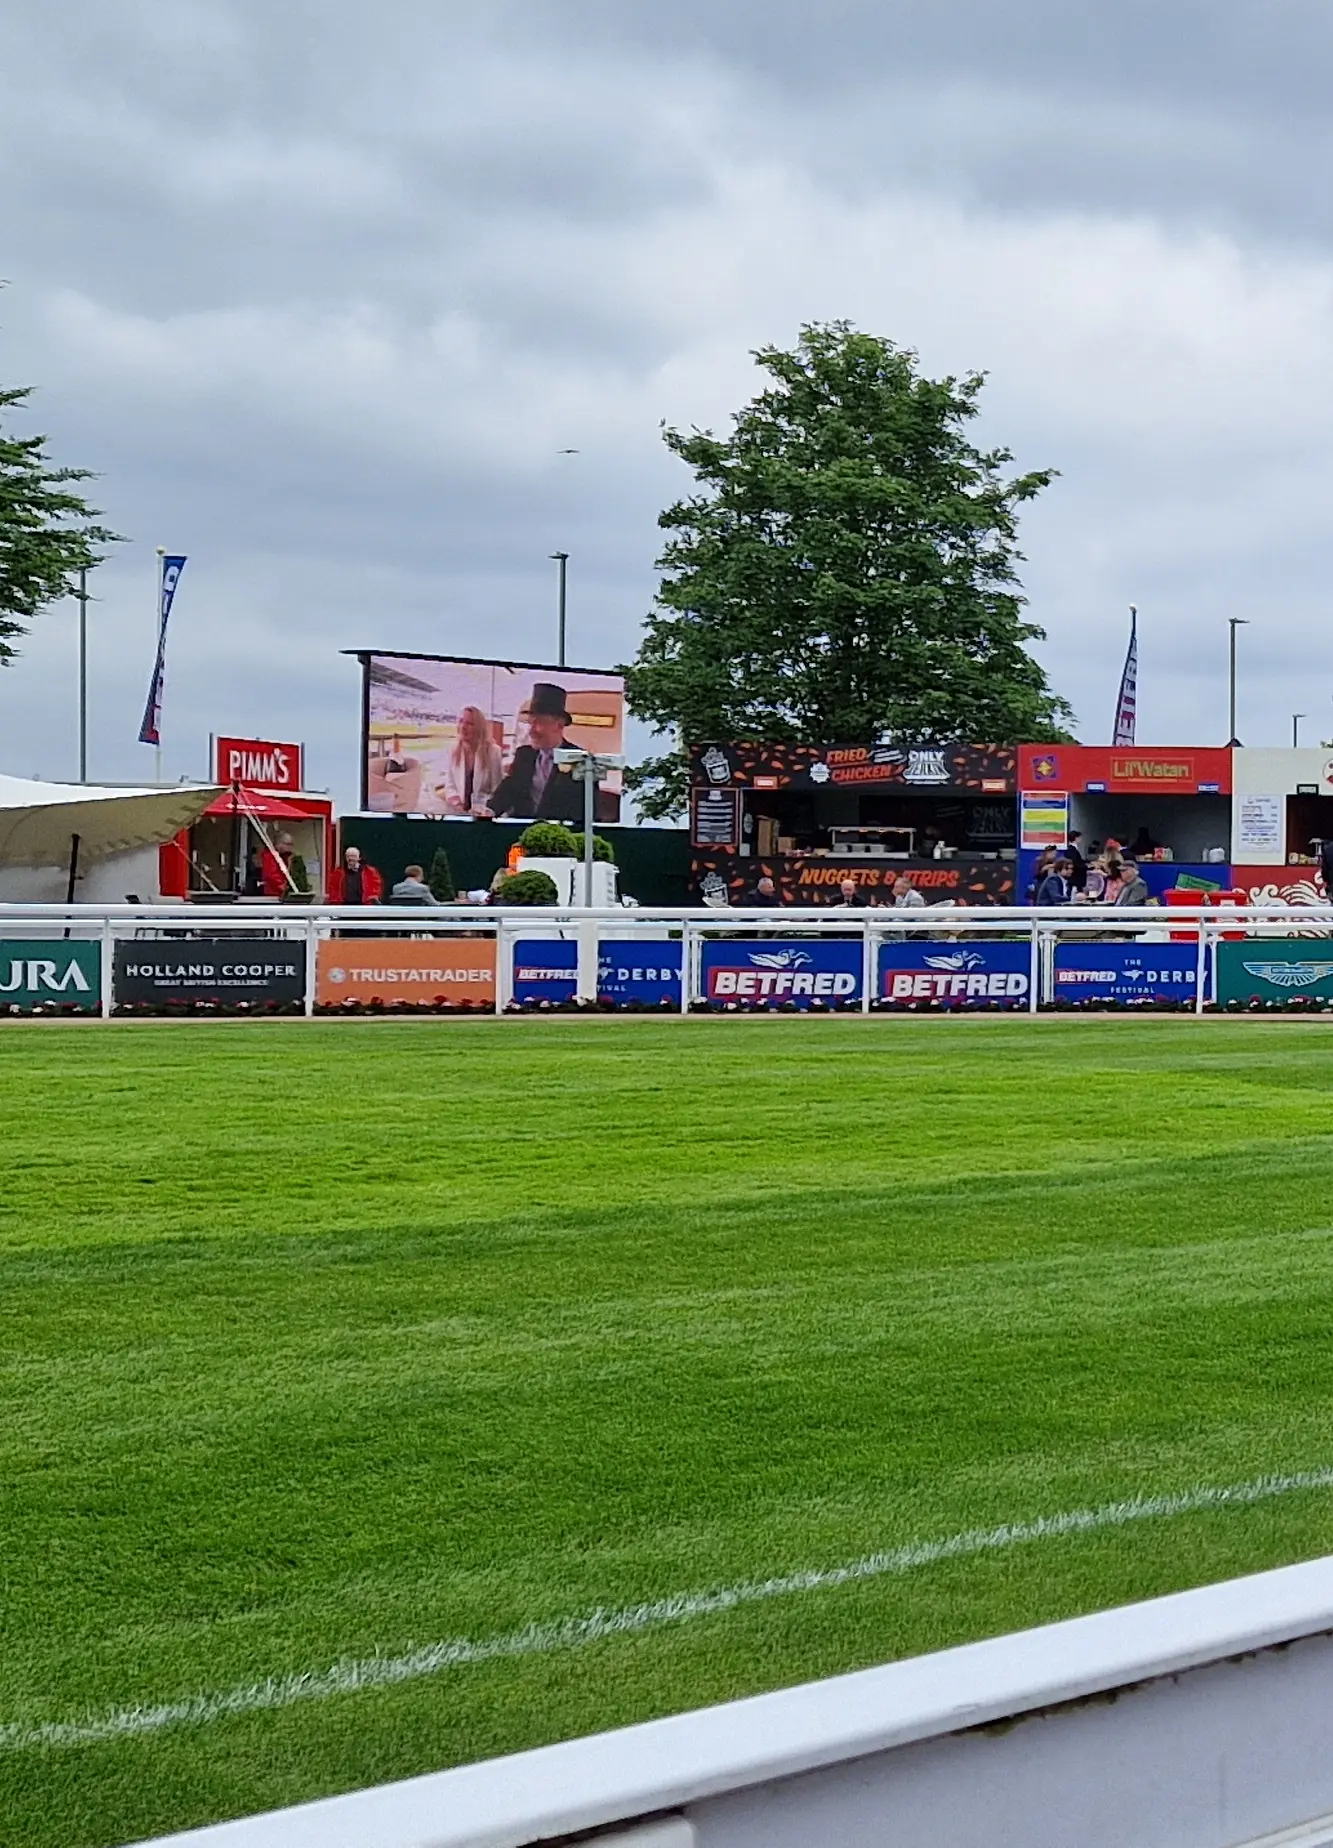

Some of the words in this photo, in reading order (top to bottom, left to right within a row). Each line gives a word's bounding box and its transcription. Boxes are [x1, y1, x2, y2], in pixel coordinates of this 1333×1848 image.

[827, 748, 866, 763] FRIED
[908, 750, 944, 762] ONLY
[229, 748, 290, 784] PIMM'S
[832, 764, 893, 781] CHICKEN
[799, 867, 880, 887] NUGGETS
[883, 869, 897, 885] &
[126, 964, 214, 977] HOLLAND
[222, 964, 297, 977] COOPER
[350, 968, 493, 983] TRUSTATRADER
[616, 968, 684, 981] DERBY
[1058, 970, 1117, 982] BETFRED
[714, 972, 857, 996] BETFRED
[893, 972, 1029, 997] BETFRED
